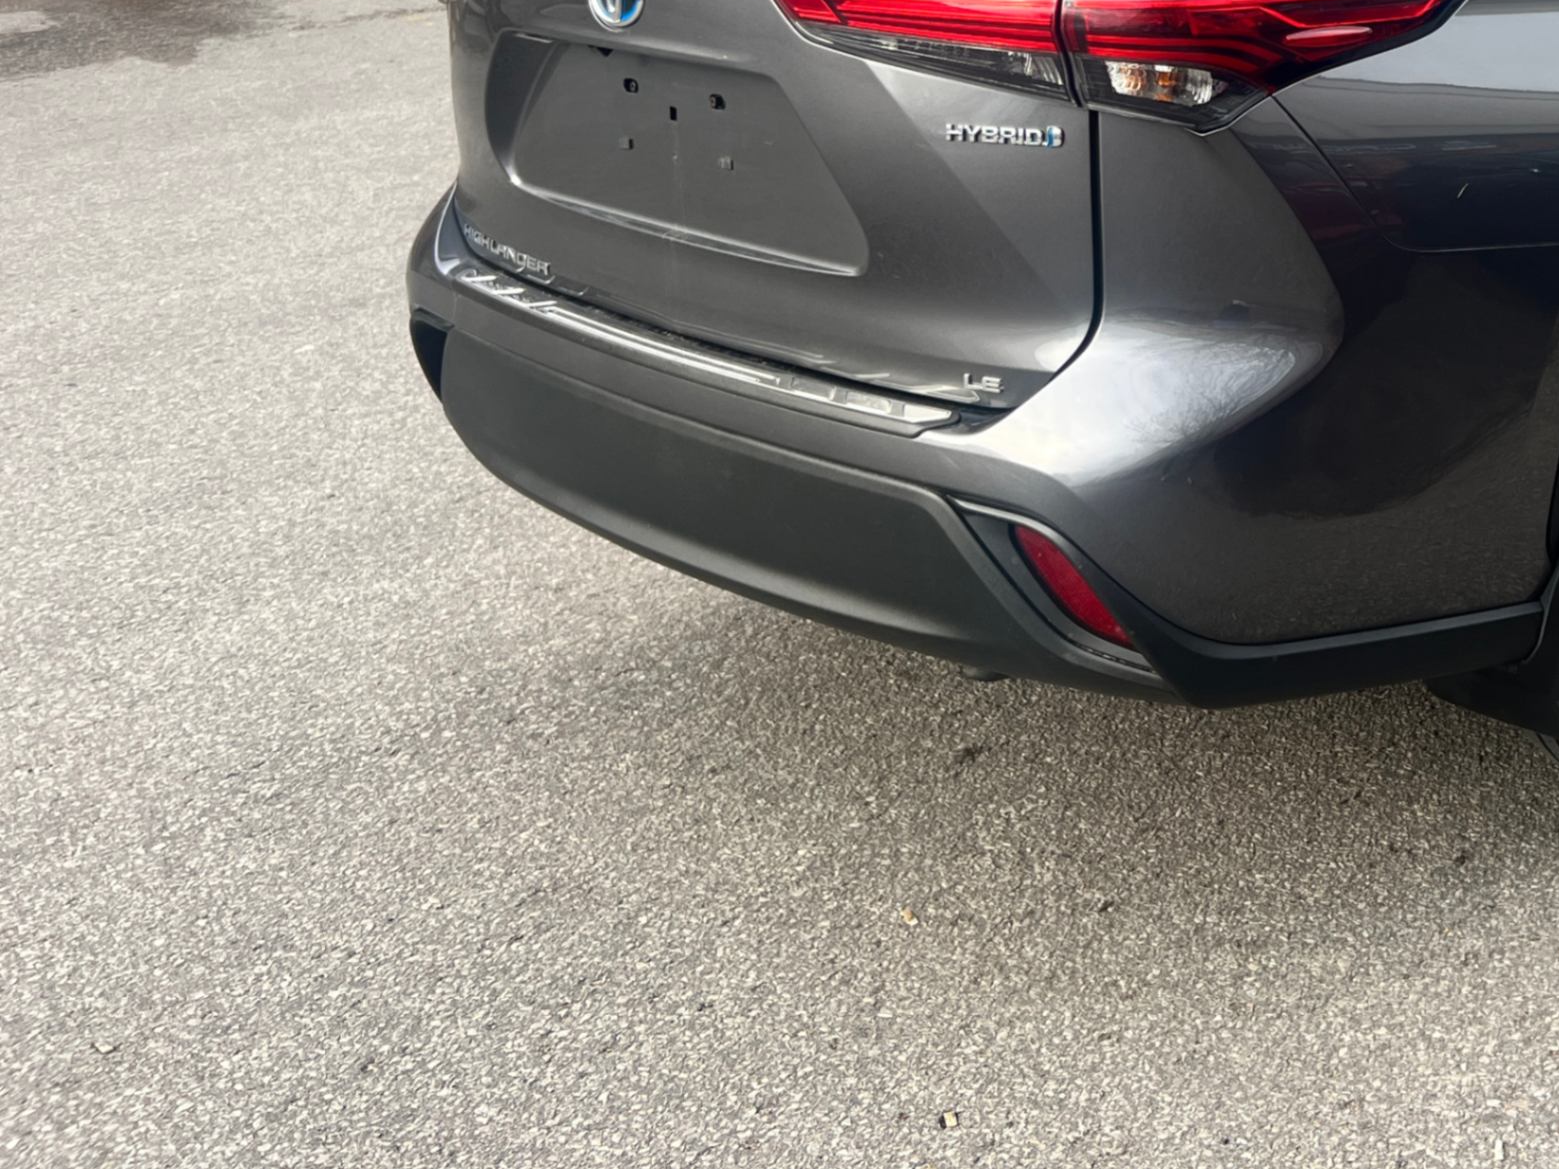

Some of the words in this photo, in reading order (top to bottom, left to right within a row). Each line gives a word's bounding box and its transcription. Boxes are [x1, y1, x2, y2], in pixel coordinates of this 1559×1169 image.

[945, 123, 1042, 146] HYBRID
[464, 223, 551, 276] HIGHLANDER
[963, 372, 1002, 393] LE
